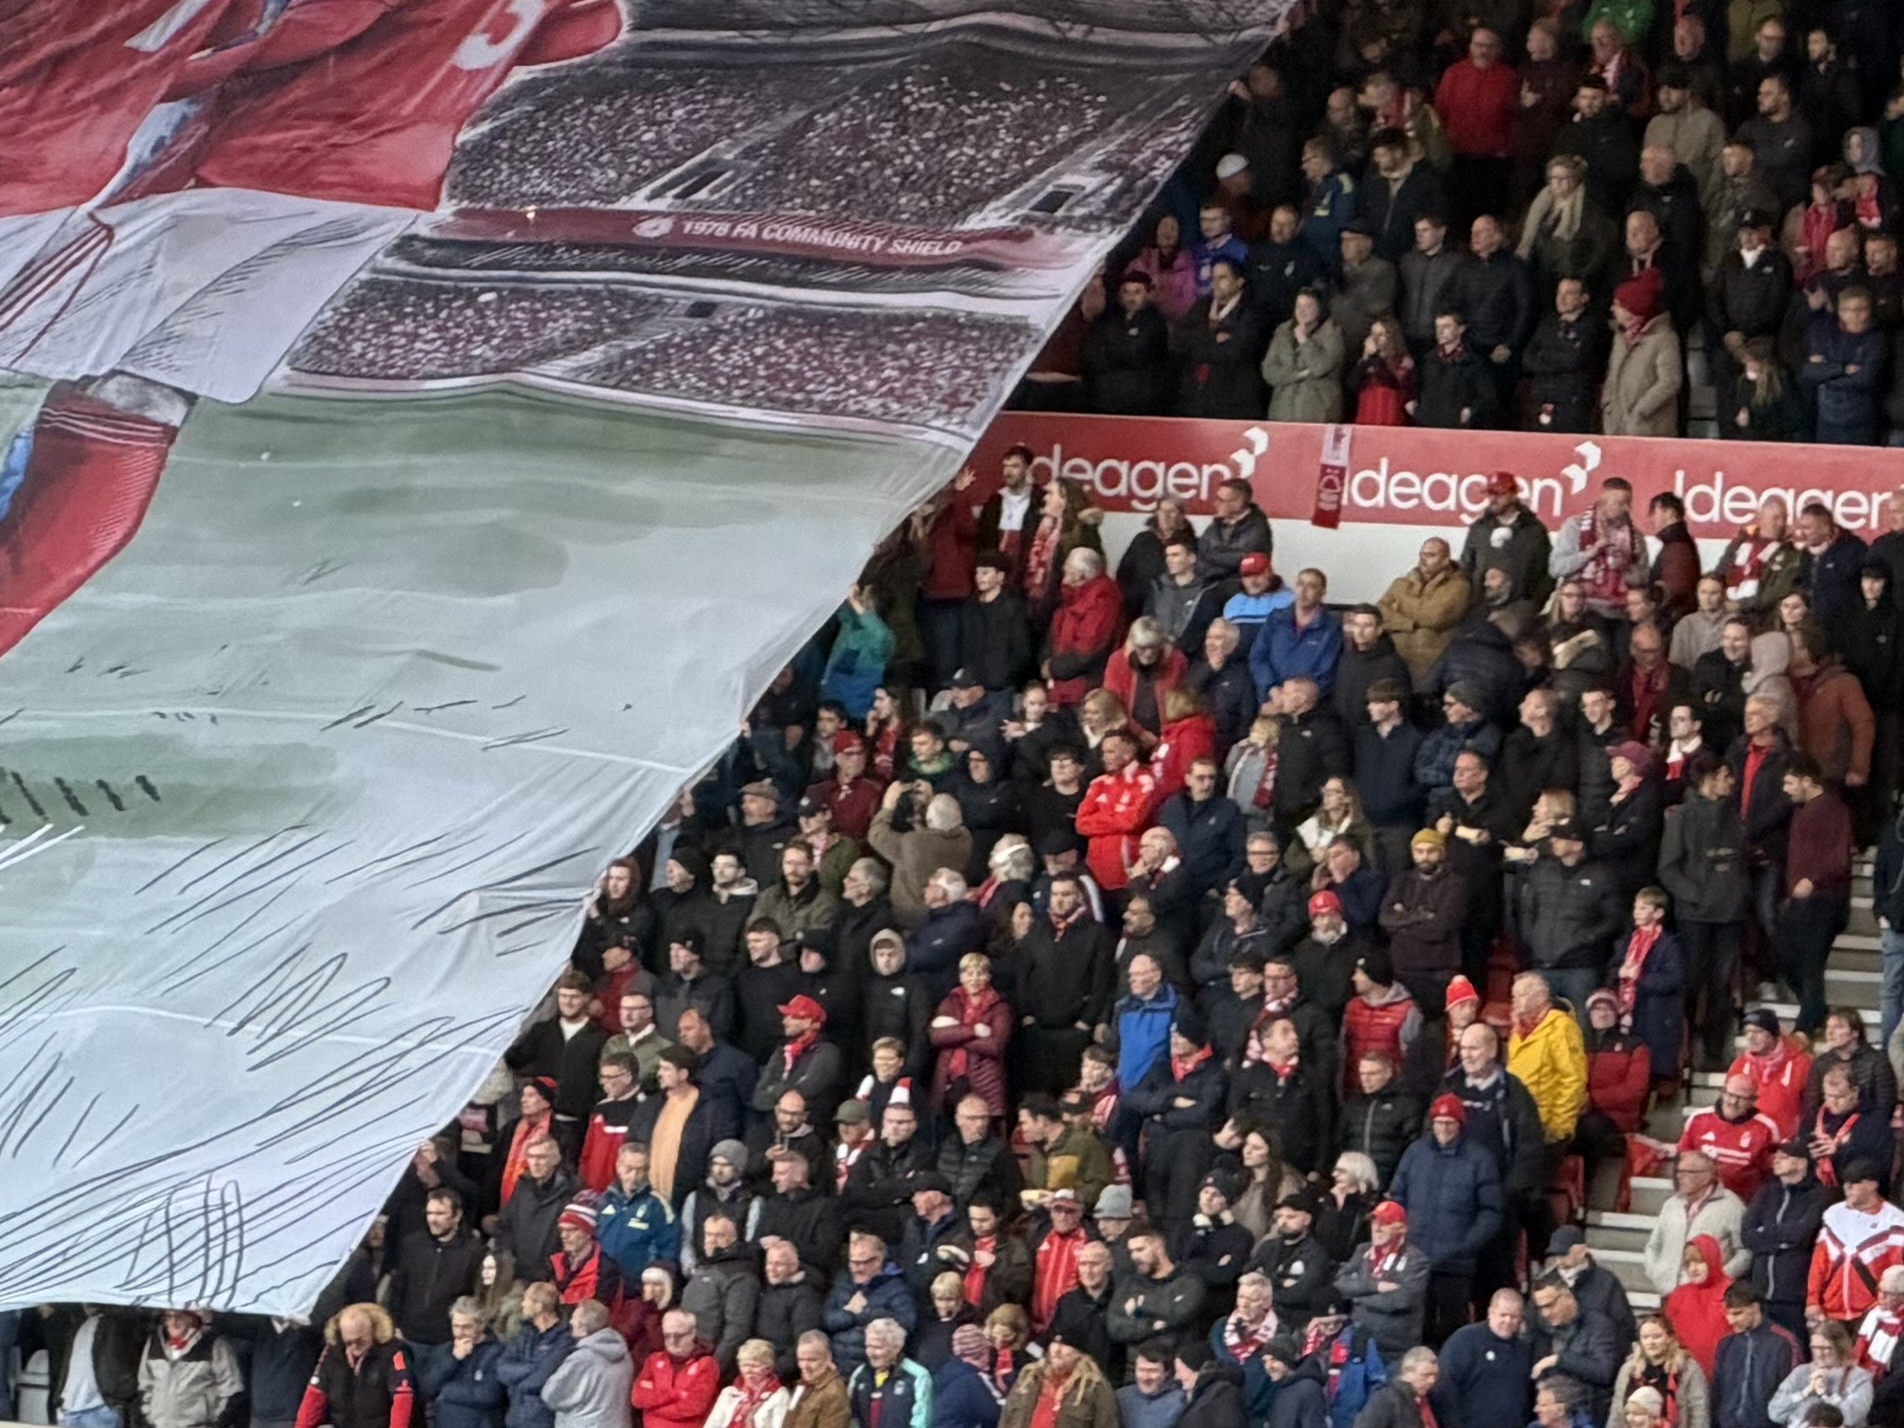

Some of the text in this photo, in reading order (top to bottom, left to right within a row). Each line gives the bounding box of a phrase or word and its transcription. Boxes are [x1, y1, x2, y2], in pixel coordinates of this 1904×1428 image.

[682, 221, 964, 258] 1978 FA COMMUNITY SHIELD
[1018, 442, 1232, 512] deagen
